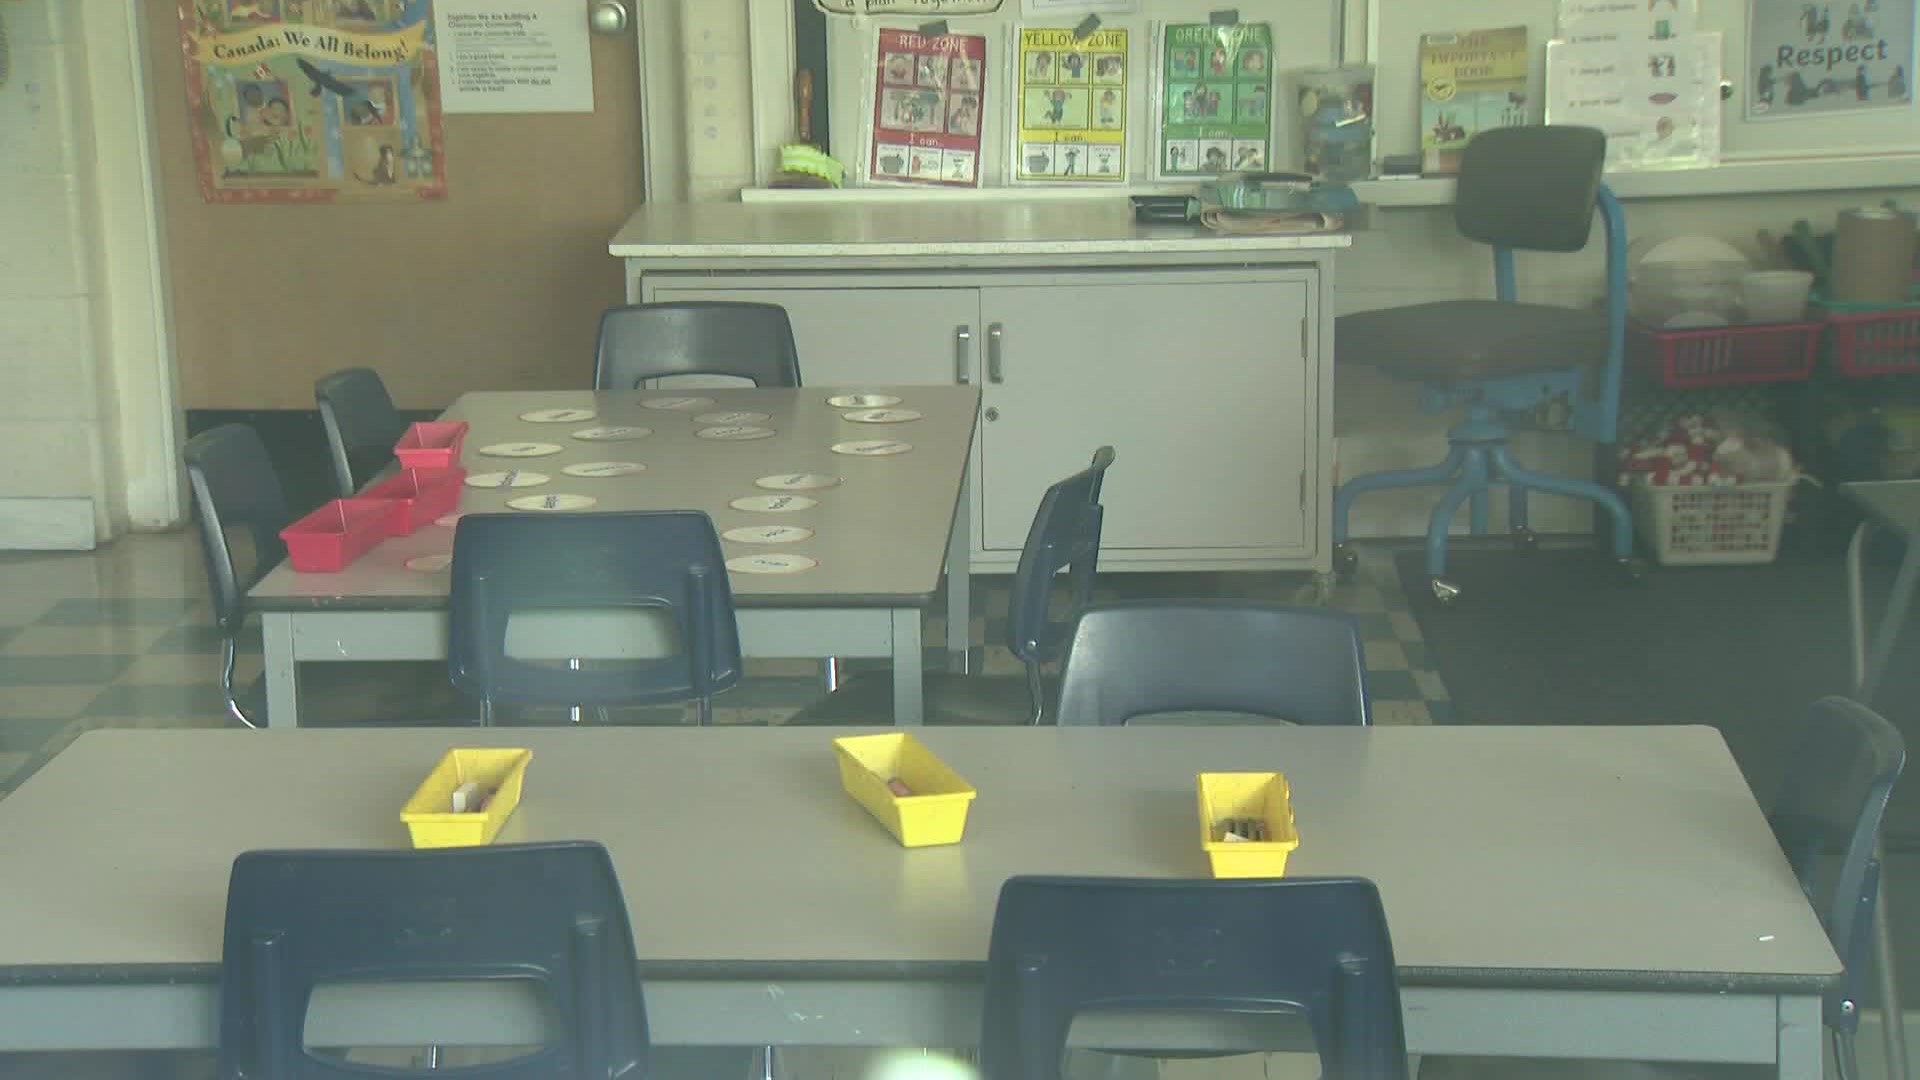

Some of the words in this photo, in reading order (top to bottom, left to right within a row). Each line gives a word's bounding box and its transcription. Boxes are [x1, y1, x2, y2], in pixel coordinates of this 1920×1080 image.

[213, 35, 281, 59] Canada:
[283, 30, 311, 46] We
[314, 35, 339, 52] All
[343, 37, 409, 63] Belong!
[900, 35, 928, 49] RED
[932, 37, 967, 53] ZONE
[1087, 34, 1123, 48] ZONE
[1776, 39, 1889, 71] Respect
